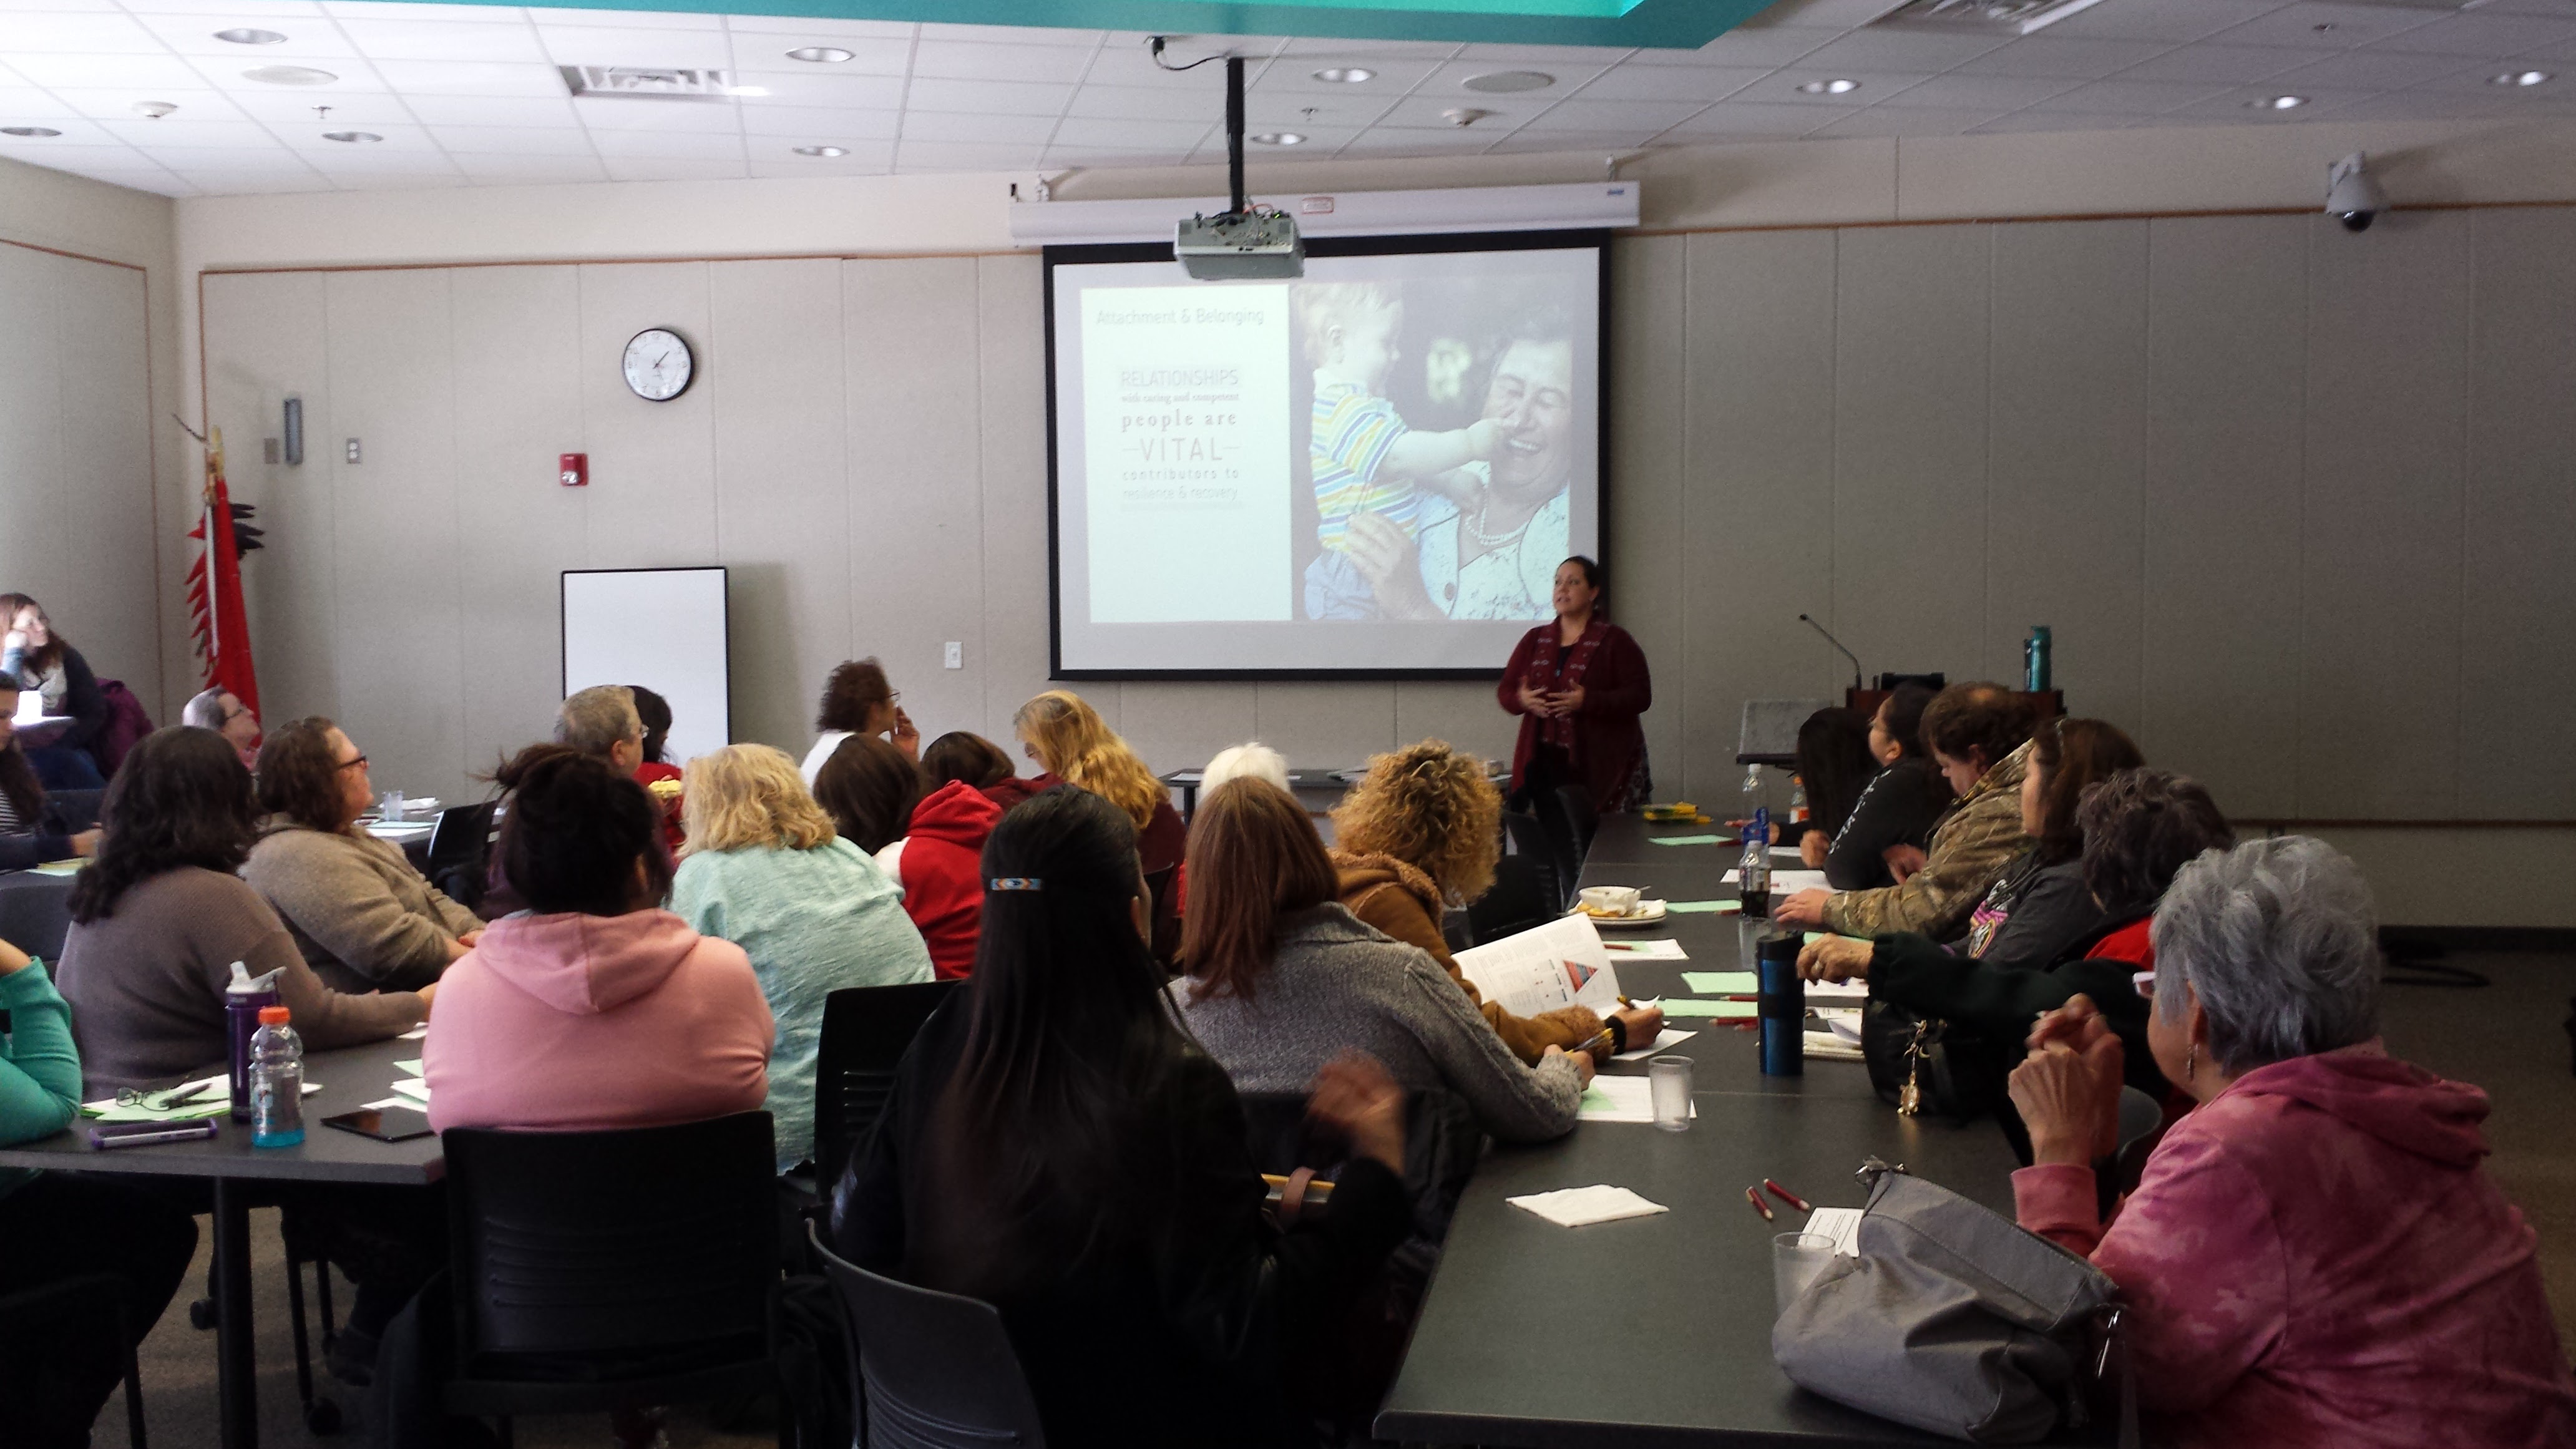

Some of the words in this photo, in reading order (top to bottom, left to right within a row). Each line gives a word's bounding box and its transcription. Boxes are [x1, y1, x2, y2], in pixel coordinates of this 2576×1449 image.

[1096, 310, 1176, 324] Attachment
[1181, 308, 1191, 323] &
[1196, 307, 1264, 326] Belonging
[1121, 369, 1239, 386] RELATIONSHIPS
[1121, 392, 1141, 402] with
[1143, 393, 1171, 404] caring
[1173, 391, 1190, 402] and
[1192, 394, 1239, 404] competent
[1121, 408, 1193, 432] people
[1204, 413, 1237, 426] are
[1139, 437, 1223, 461] VITAL
[1123, 467, 1217, 481] contributors
[1225, 467, 1239, 479] to
[1123, 487, 1174, 500] resilience
[1178, 485, 1188, 499] &
[1191, 487, 1238, 501] recovery
